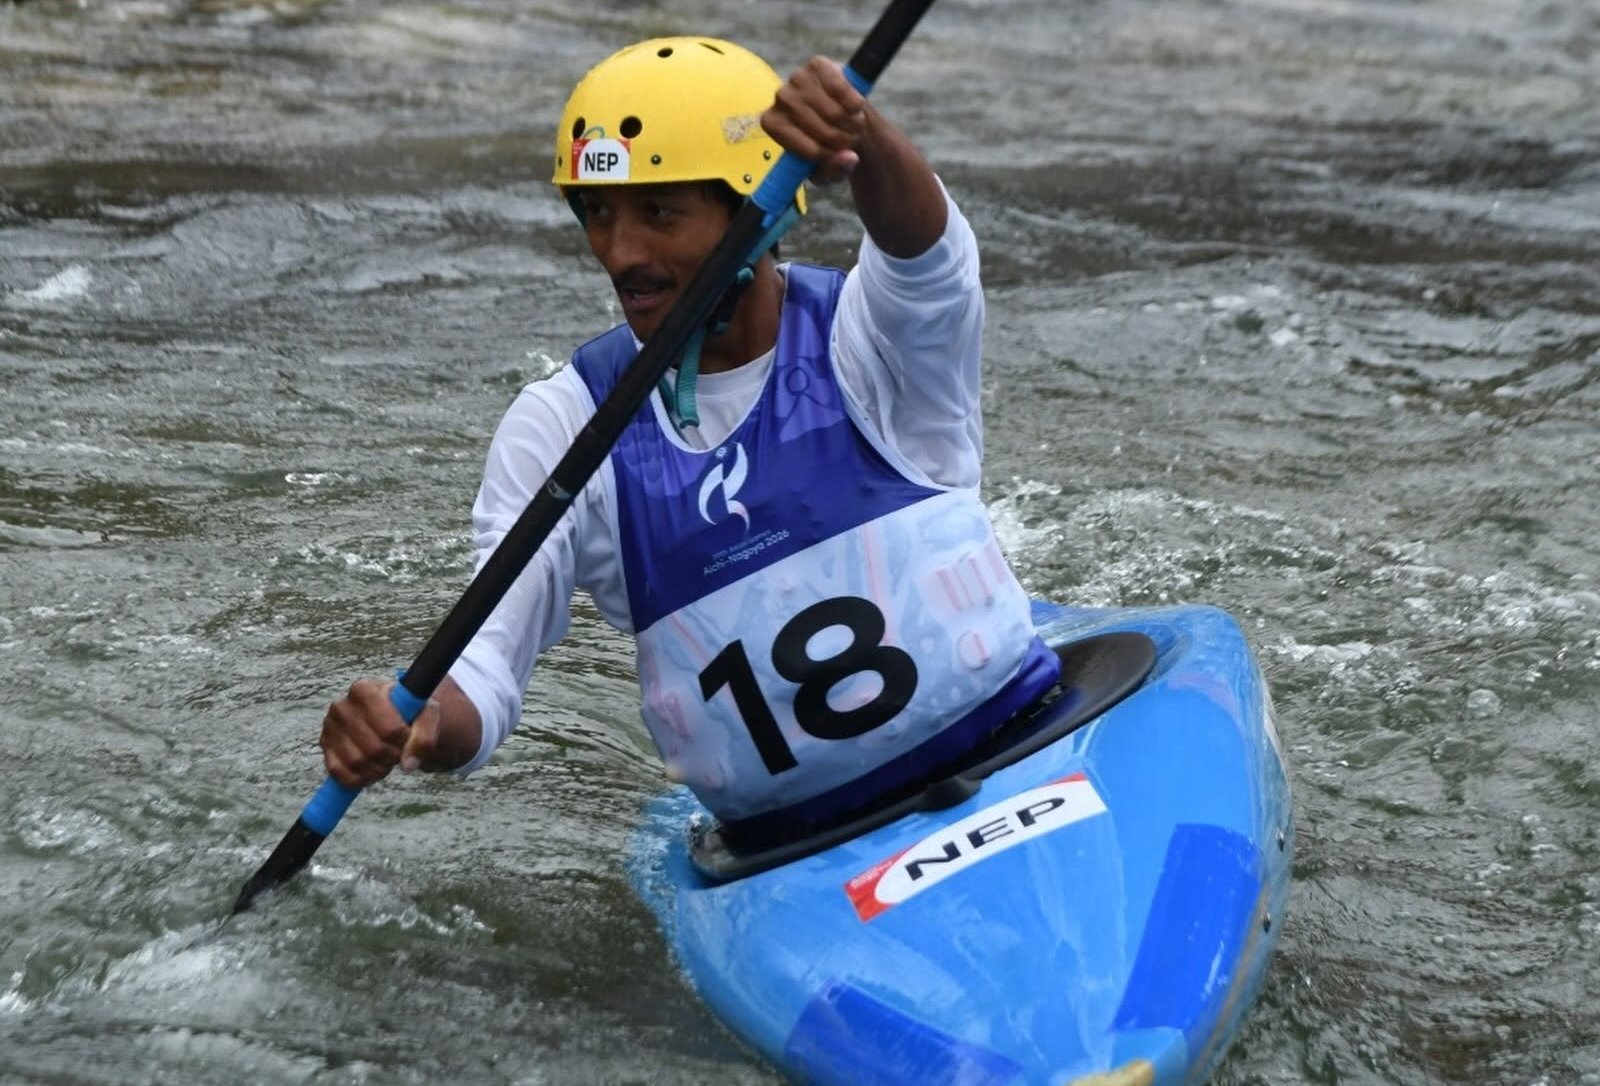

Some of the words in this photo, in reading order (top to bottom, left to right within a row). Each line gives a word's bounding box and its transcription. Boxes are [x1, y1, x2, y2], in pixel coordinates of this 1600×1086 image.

[584, 152, 619, 172] NEP
[765, 529, 790, 547] 2026
[697, 596, 918, 776] 18
[904, 797, 1066, 881] NEP
